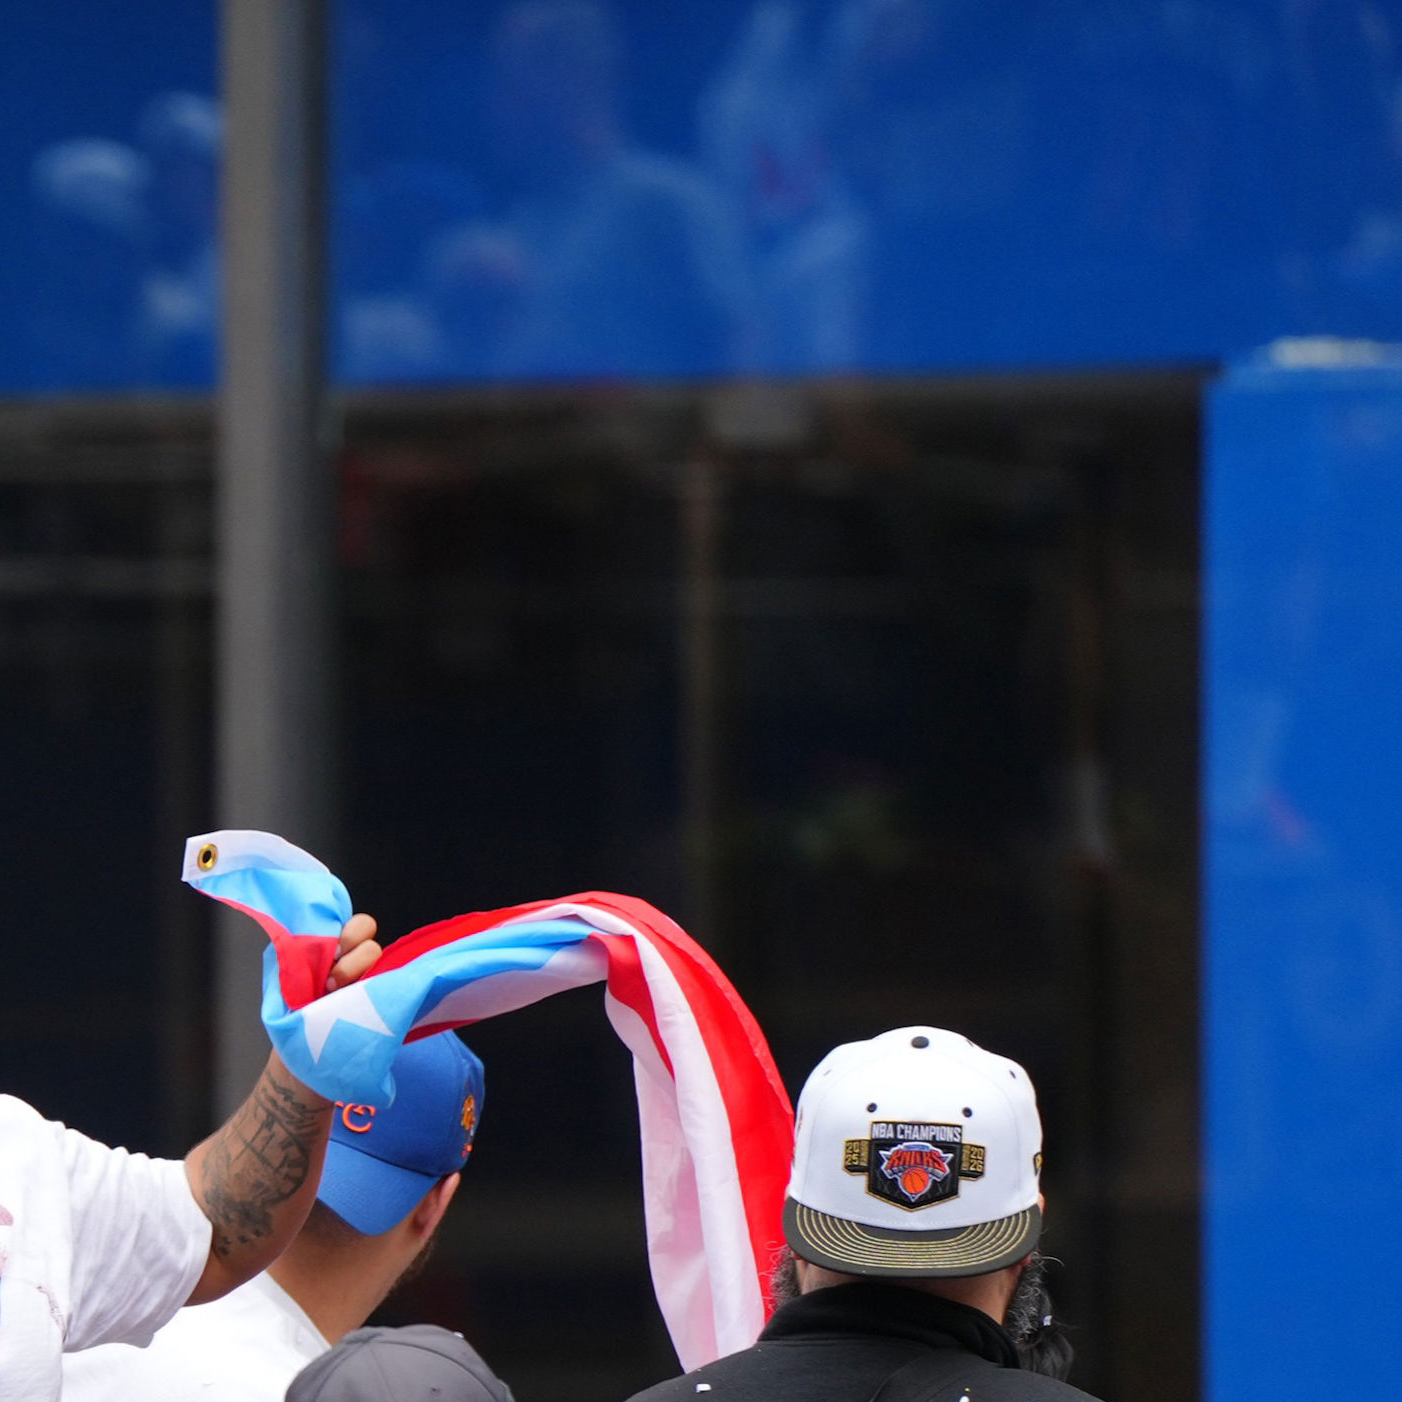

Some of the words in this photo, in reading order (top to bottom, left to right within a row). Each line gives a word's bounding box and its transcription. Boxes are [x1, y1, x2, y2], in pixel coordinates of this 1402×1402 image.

[872, 1123, 894, 1139] NBA
[897, 1124, 962, 1142] CHAMPIONS
[885, 1149, 947, 1173] KNICKS
